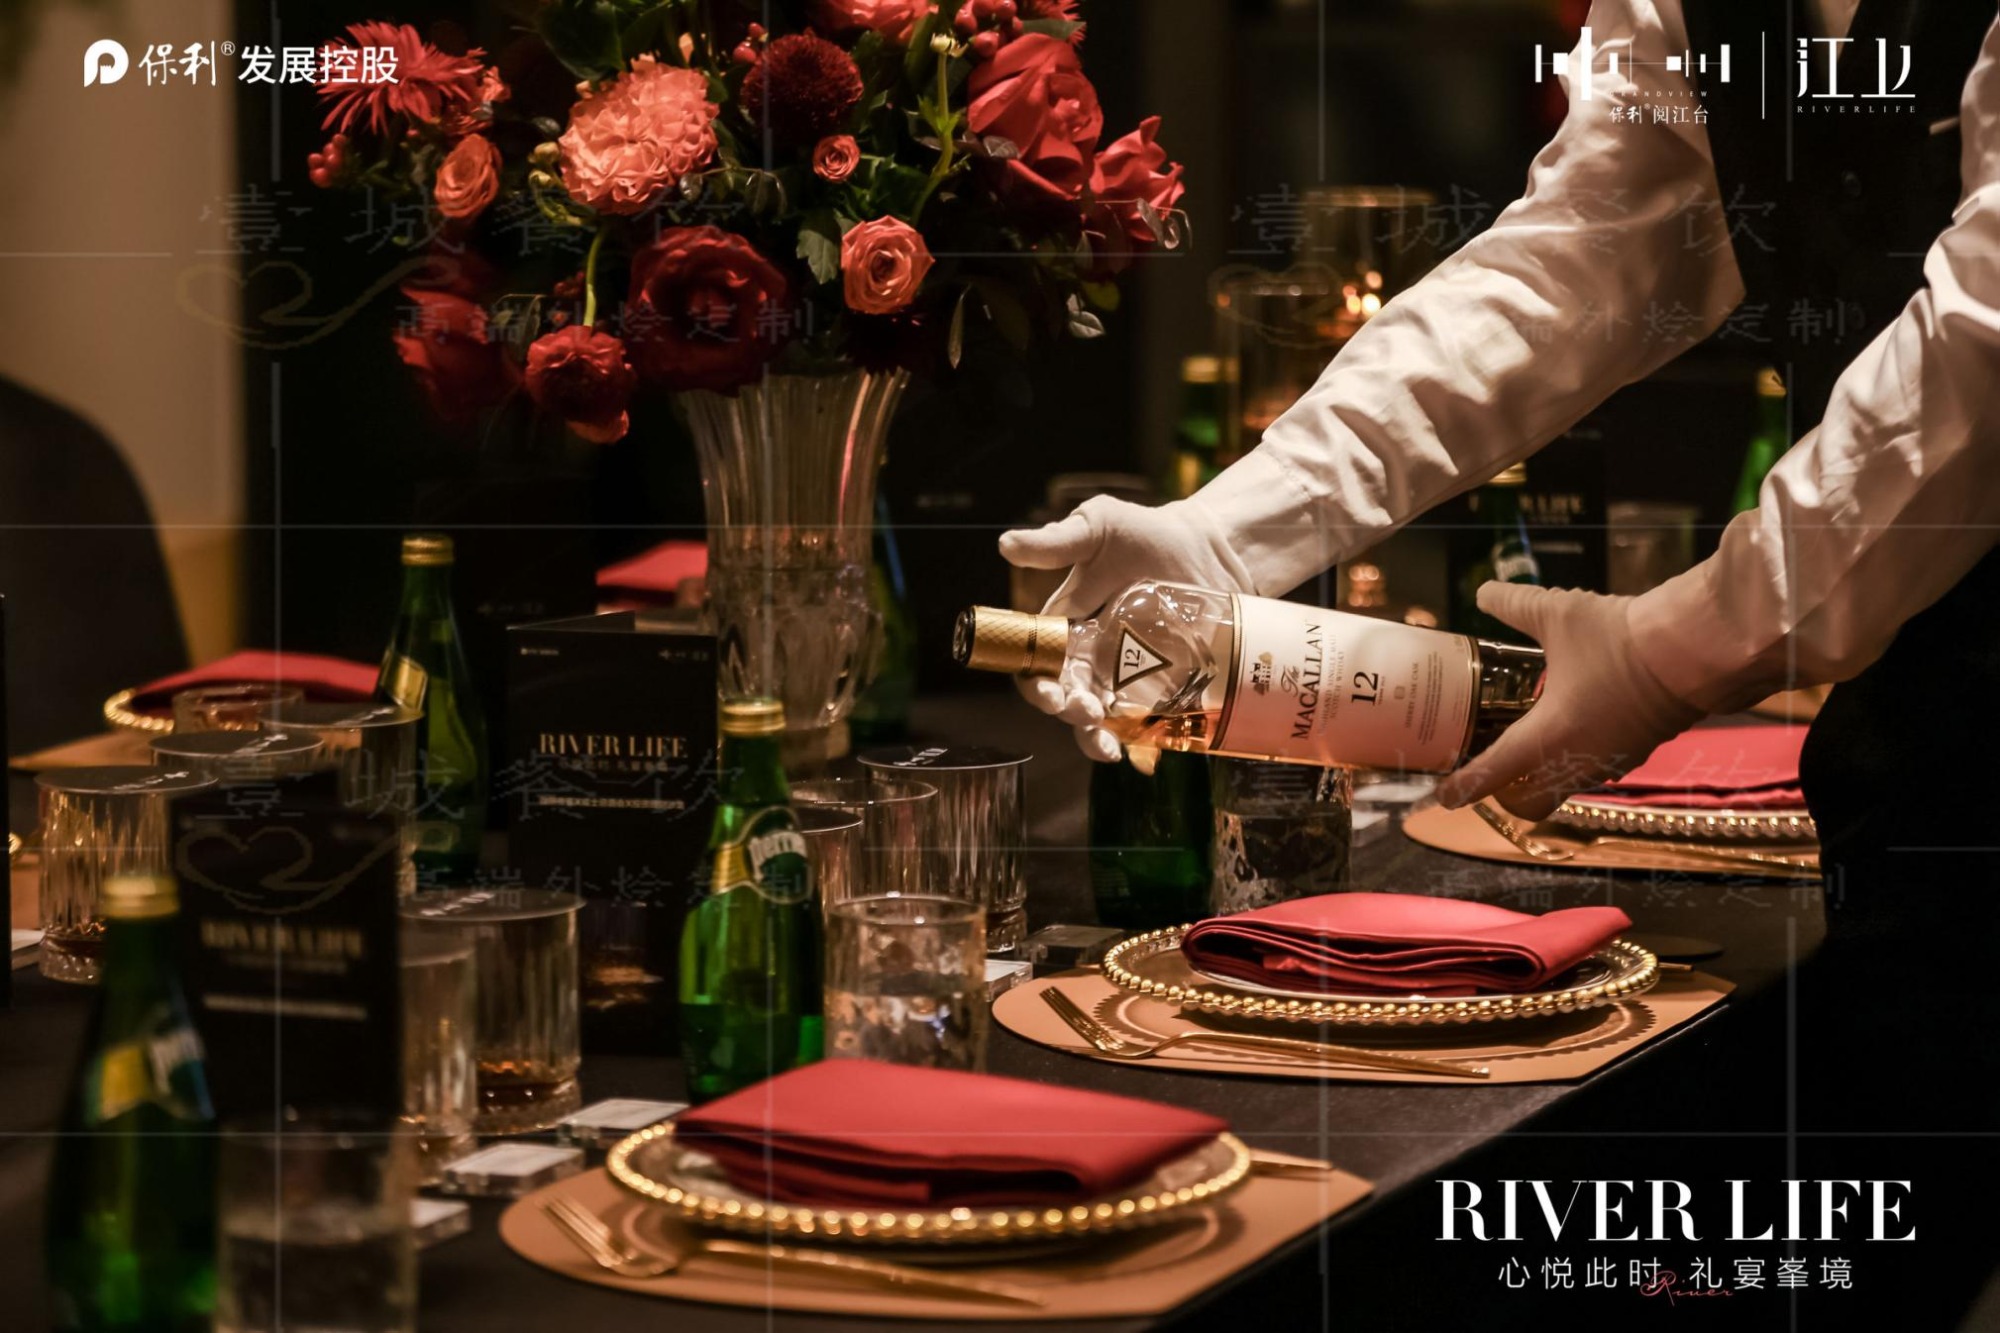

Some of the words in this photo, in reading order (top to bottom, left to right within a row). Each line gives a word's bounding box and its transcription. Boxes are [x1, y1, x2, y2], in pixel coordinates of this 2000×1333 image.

[1124, 648, 1141, 668] 12
[1281, 665, 1300, 698] The
[1290, 622, 1323, 740] MACALLAN
[1351, 671, 1380, 706] 12
[539, 733, 620, 756] RIVER
[628, 736, 689, 759] LIFE
